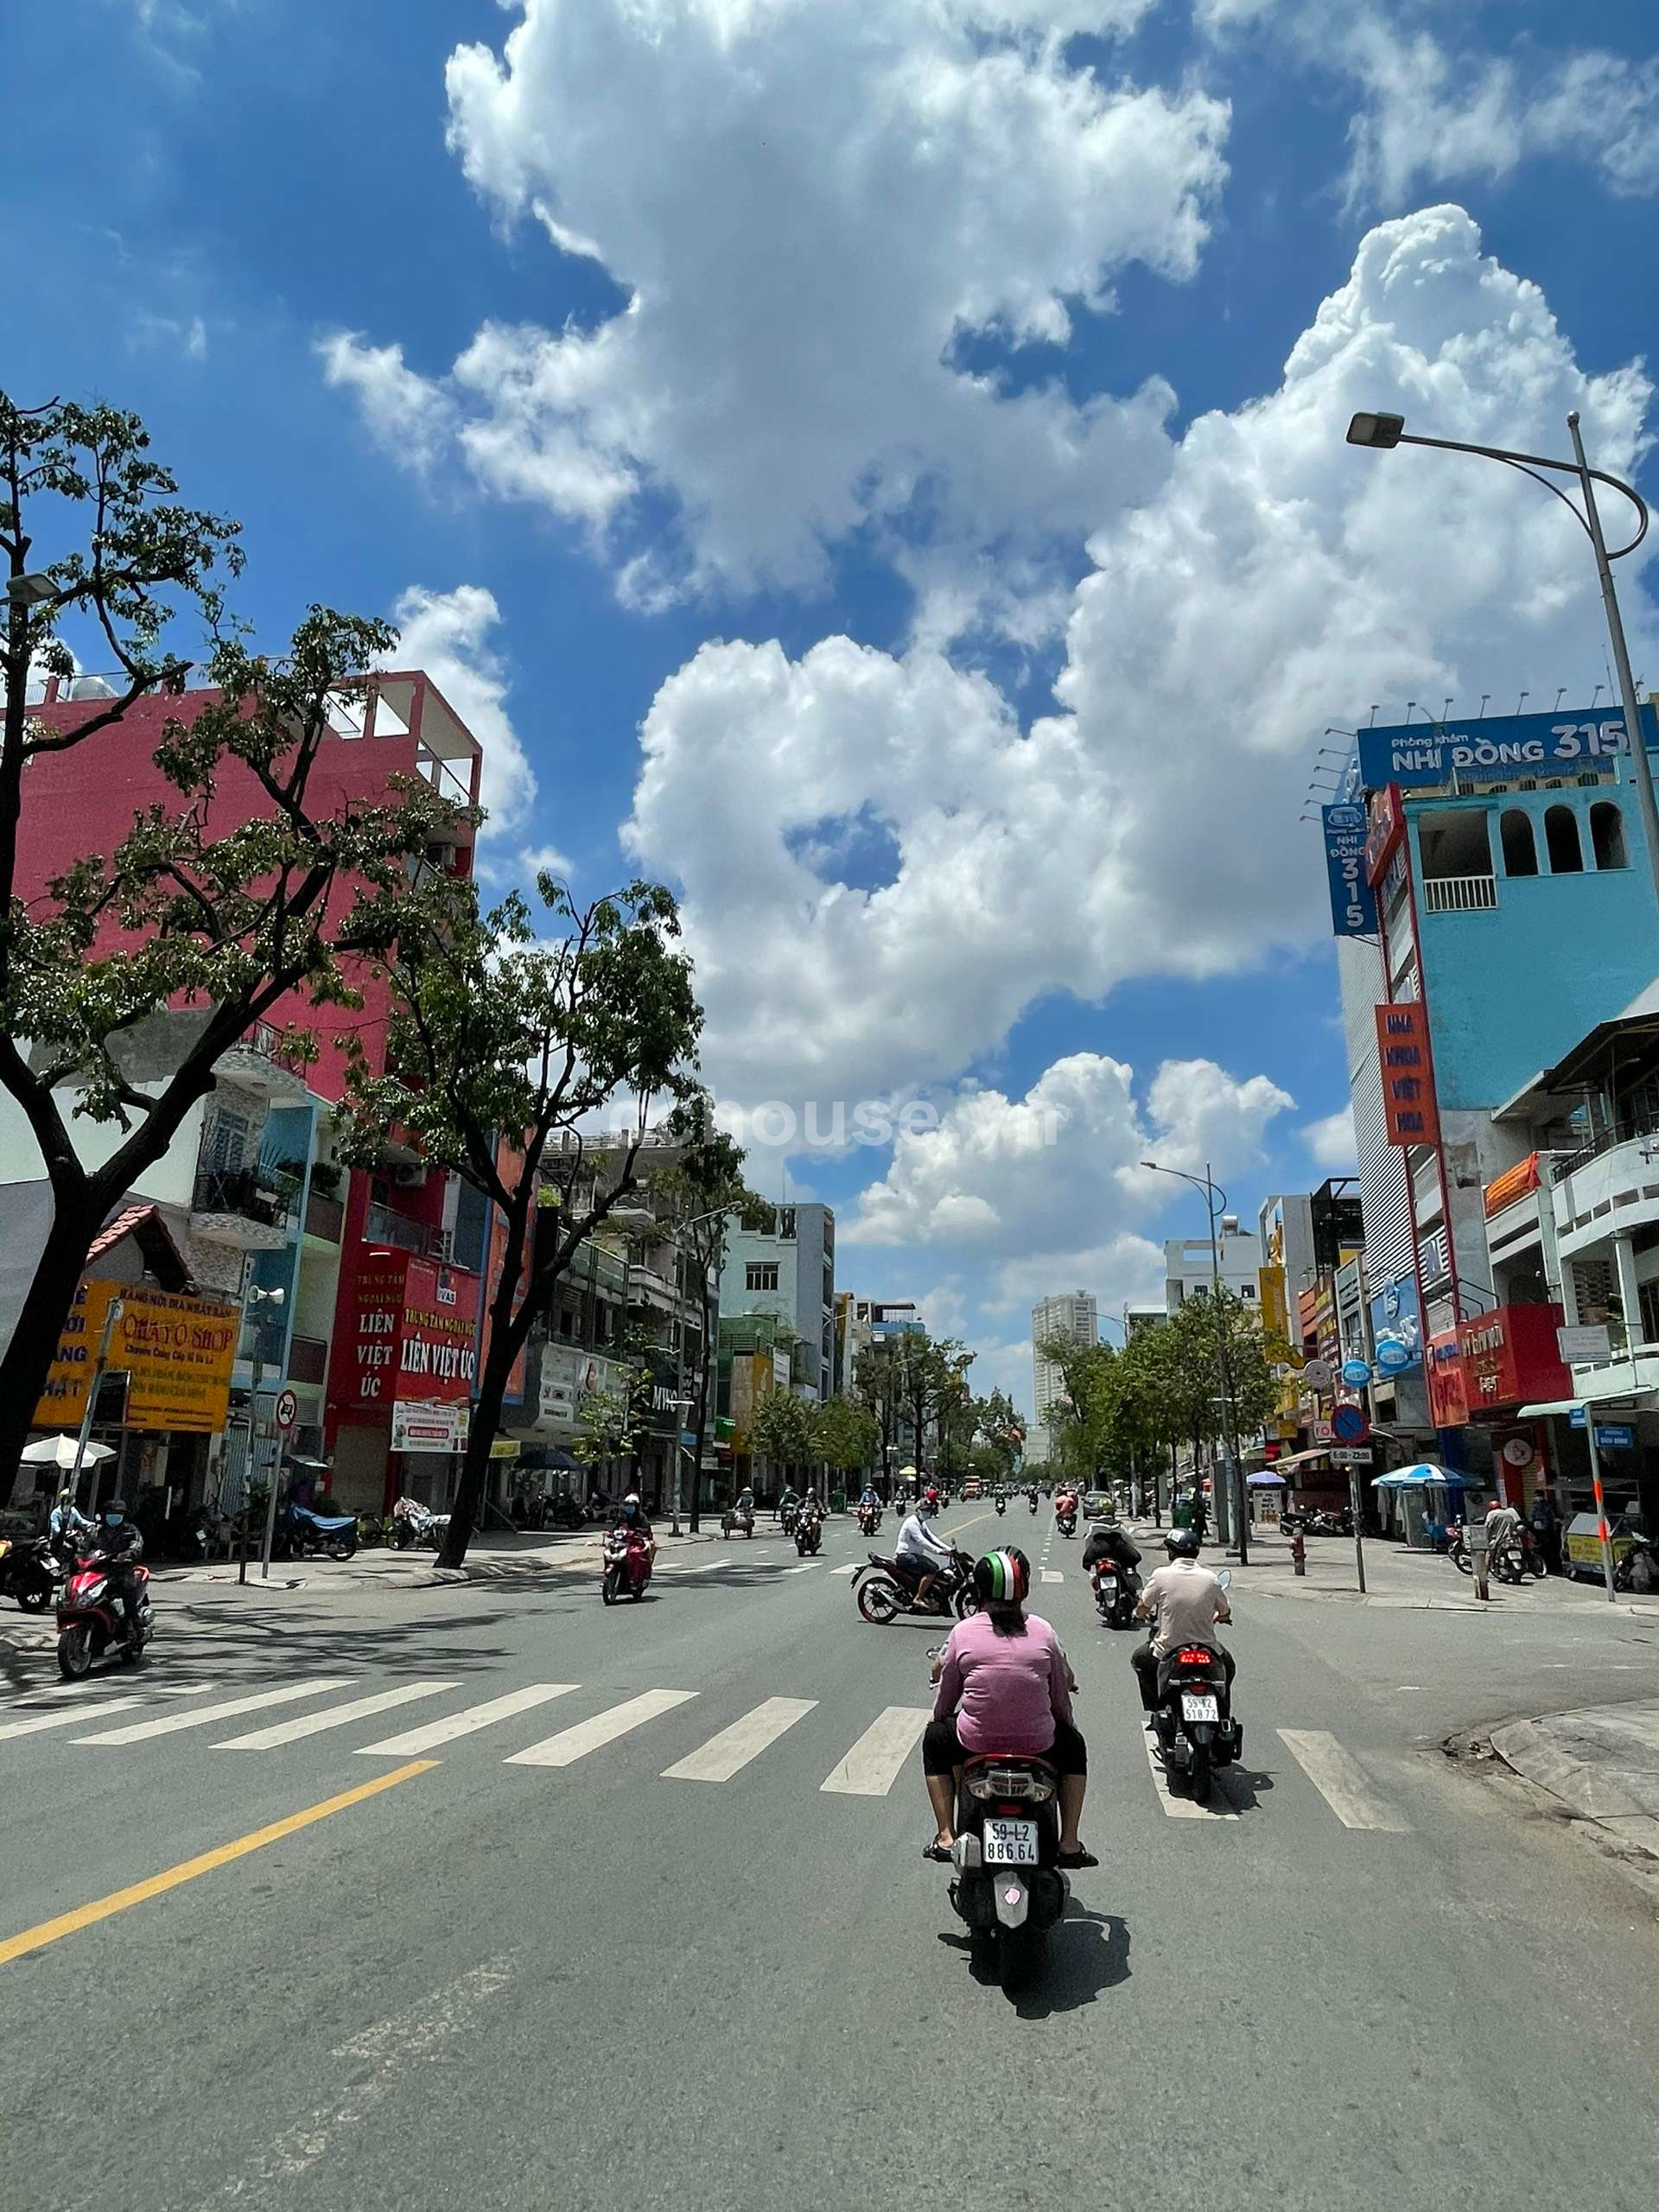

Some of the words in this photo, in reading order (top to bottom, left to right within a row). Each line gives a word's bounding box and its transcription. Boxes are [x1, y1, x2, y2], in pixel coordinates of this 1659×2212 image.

[1392, 748, 1443, 772] NHI
[1452, 736, 1545, 768] ĐỒNG
[1551, 721, 1628, 759] 315
[1337, 836, 1357, 845] NHI
[359, 1307, 395, 1333] LIÊN
[357, 1339, 393, 1370] VIỆT
[400, 1331, 430, 1374] LIÊN
[433, 1338, 459, 1385] VIỆT
[460, 1340, 475, 1380] ÚC
[359, 1371, 381, 1398] ÚC
[992, 1822, 1030, 1841] 59-L2
[988, 1842, 1035, 1862] 886.64
